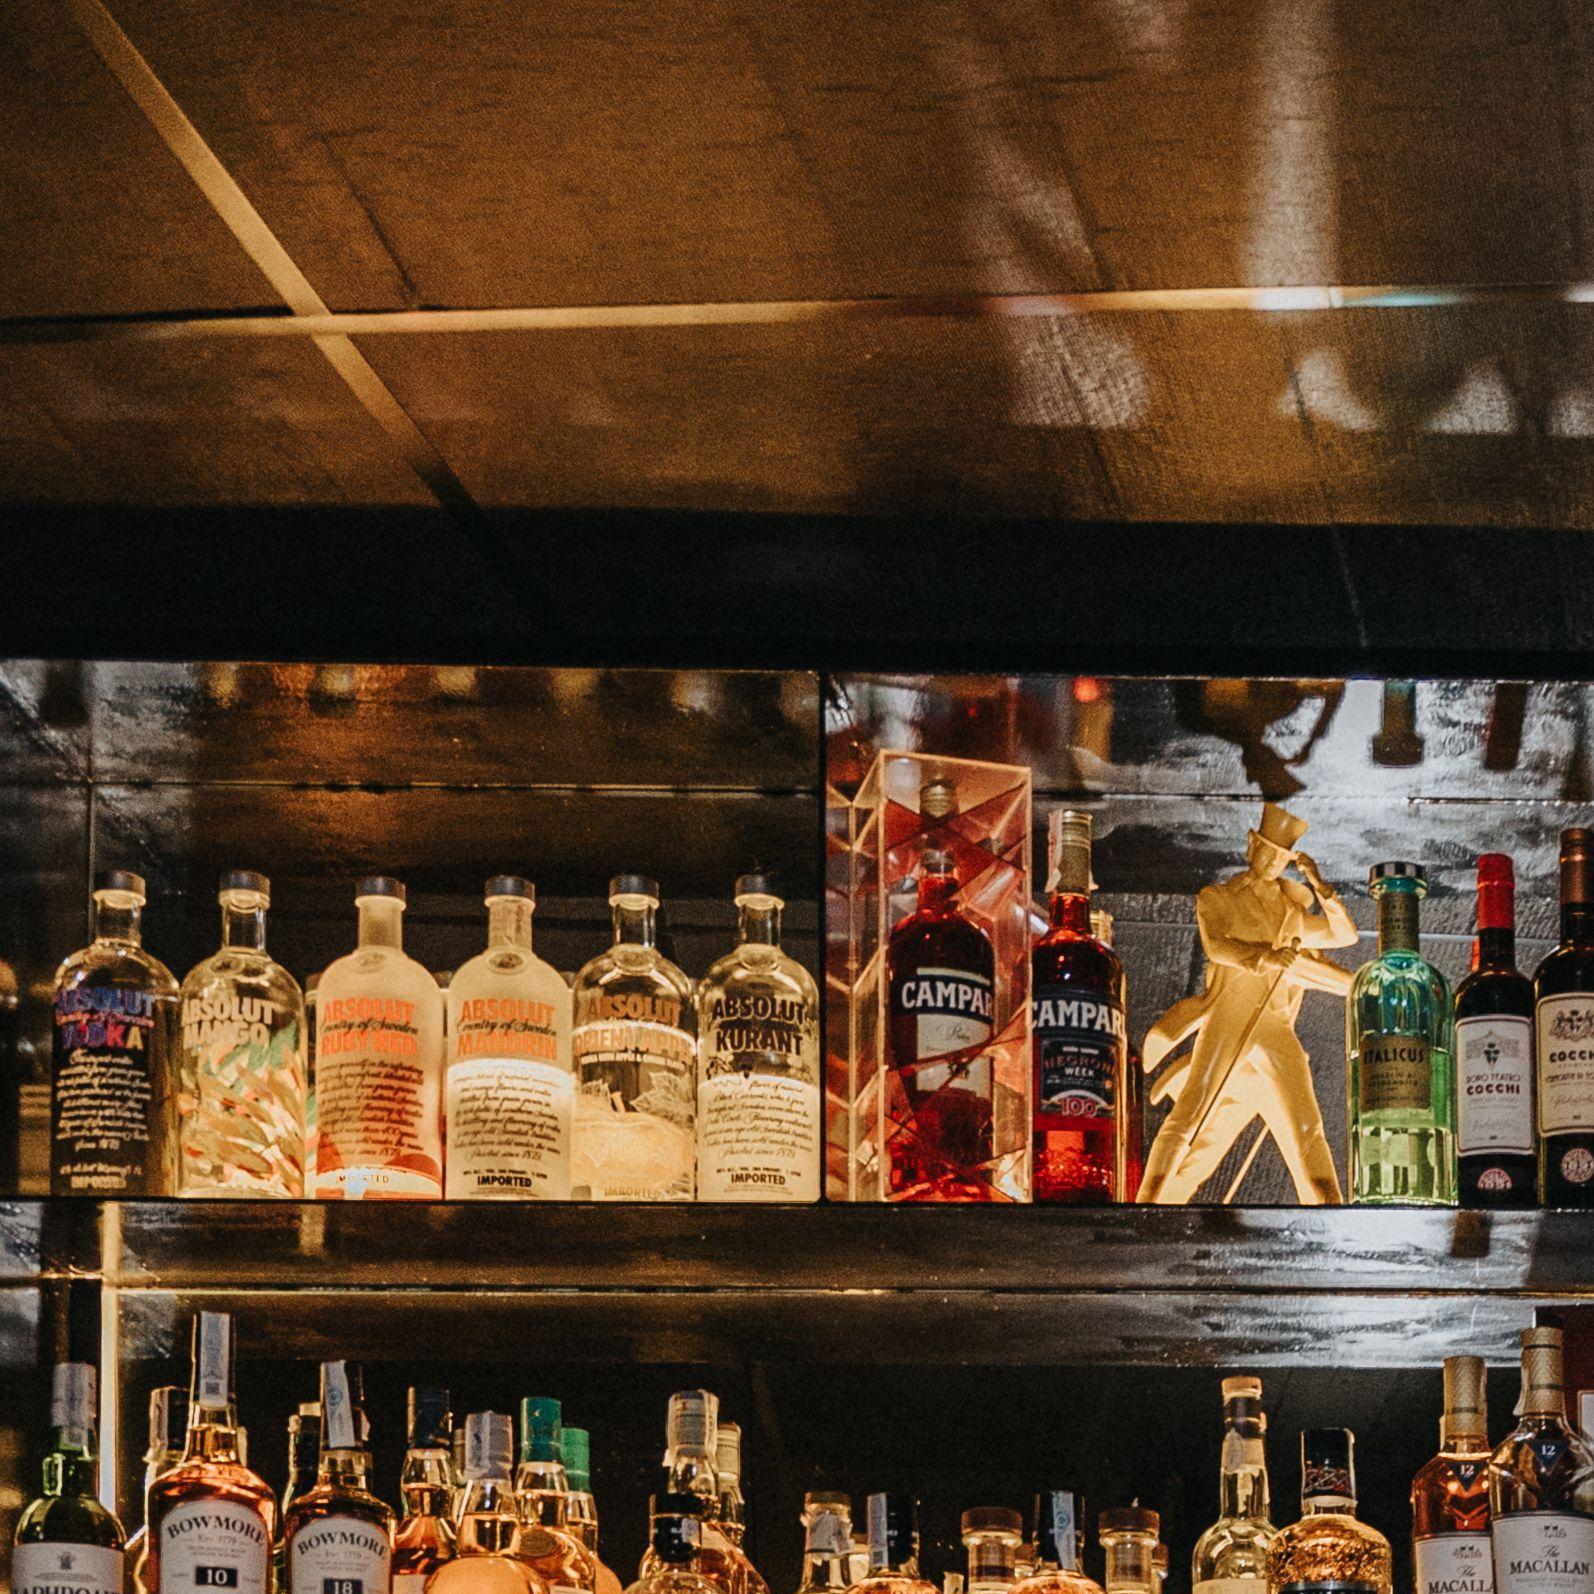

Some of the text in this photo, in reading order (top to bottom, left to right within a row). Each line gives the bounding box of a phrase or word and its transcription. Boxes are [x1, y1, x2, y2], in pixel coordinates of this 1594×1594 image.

[182, 1000, 275, 1024] ABSOLUT
[323, 998, 415, 1022] ABSOLUT
[462, 999, 555, 1024] ABSOLUT
[587, 995, 681, 1025] ABSOLUT
[711, 997, 808, 1022] ABSOLUT
[182, 1022, 270, 1050] MANGO
[372, 1030, 418, 1056] RED
[716, 1029, 803, 1056] KURANT
[1364, 1047, 1425, 1065] ITALICUS
[1064, 1066, 1095, 1077] WEEK
[1467, 1083, 1521, 1096] COCCHI
[1060, 1097, 1098, 1118] 100
[477, 1174, 533, 1188] IMPORTED
[731, 1172, 786, 1186] IMPORTED
[1540, 1443, 1556, 1458] 12
[1459, 1462, 1475, 1476] 12
[166, 1515, 266, 1545] BOWMORE
[298, 1531, 388, 1559] BOWMORE
[205, 1569, 229, 1586] 10
[1510, 1559, 1591, 1576] MACALLAN
